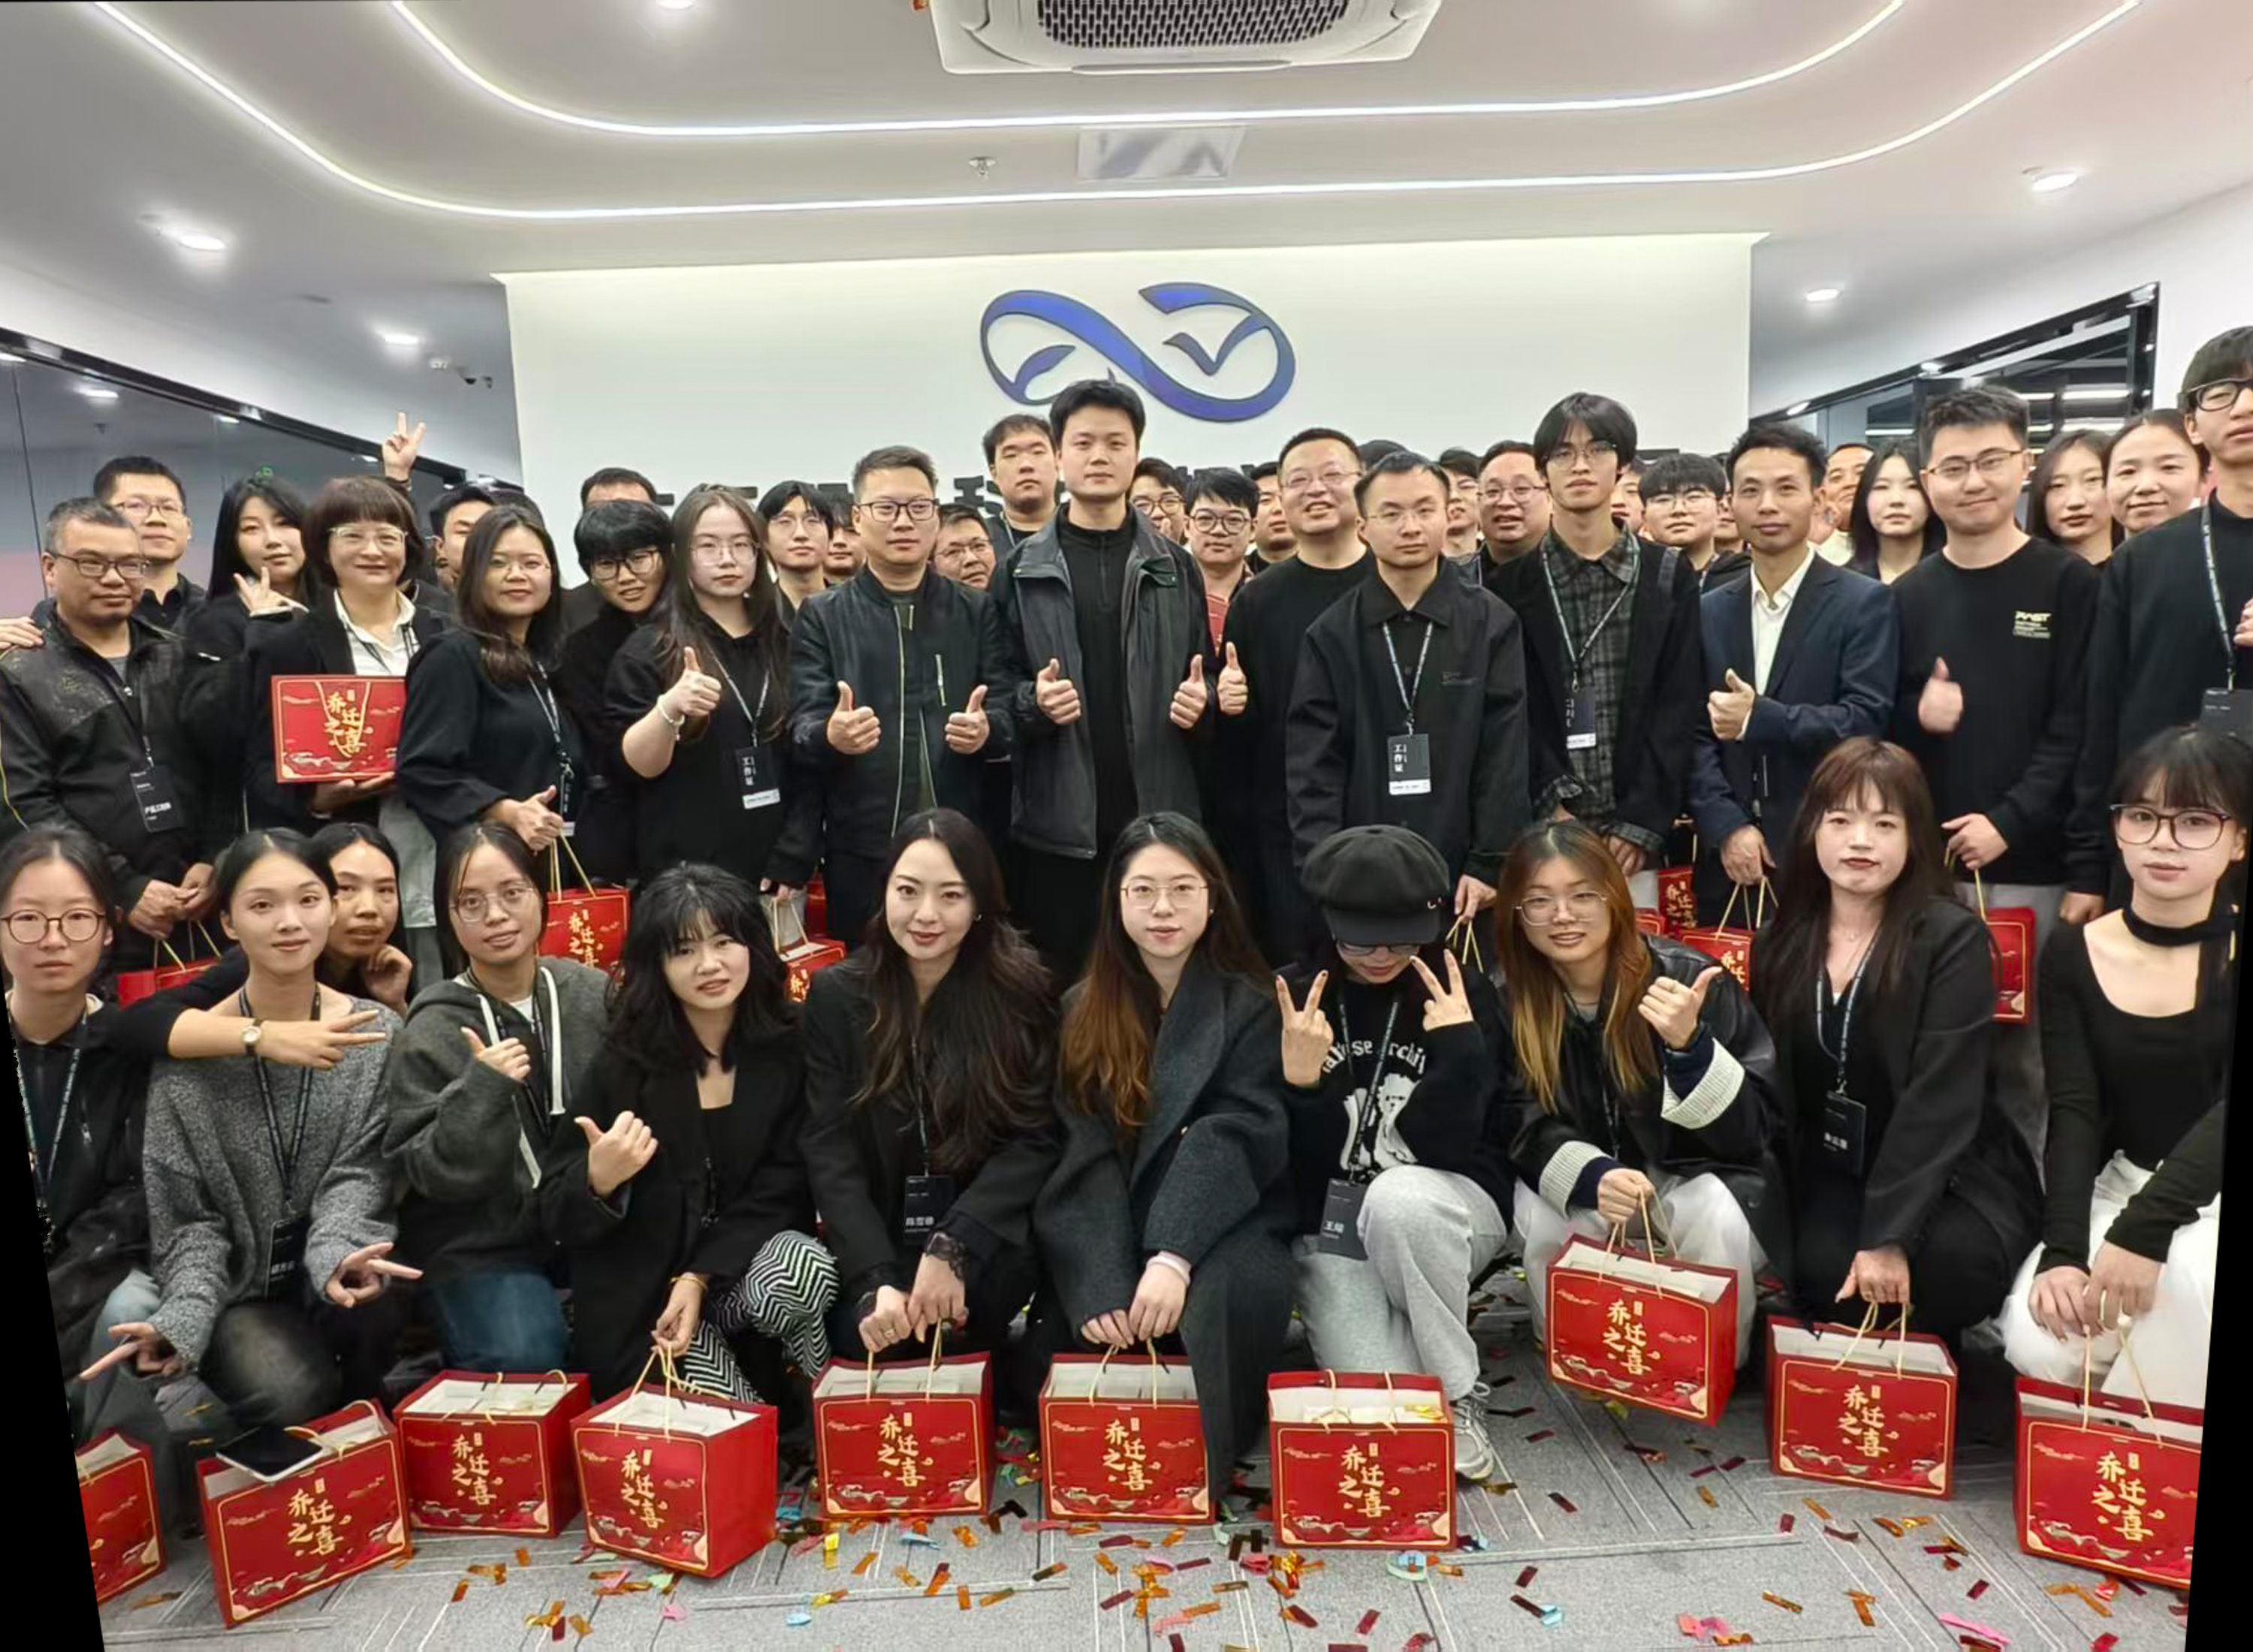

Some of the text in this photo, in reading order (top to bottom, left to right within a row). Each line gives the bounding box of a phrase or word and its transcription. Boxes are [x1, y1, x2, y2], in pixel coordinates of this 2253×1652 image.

[324, 691, 367, 753] 乔迁之喜
[569, 911, 599, 970] 乔迁之喜
[1720, 950, 1745, 984] 乔迁
[1602, 1298, 1652, 1376] 乔迁之喜
[877, 1412, 926, 1488] 乔迁之喜
[1102, 1418, 1154, 1491] 乔迁之喜
[1838, 1384, 1889, 1458] 乔迁之喜
[452, 1433, 497, 1506] 乔迁之喜
[620, 1449, 665, 1529] 乔迁之喜
[1338, 1443, 1392, 1518] 乔迁之喜
[2091, 1450, 2154, 1542] 乔迁之喜
[288, 1488, 345, 1556] 乔迁之喜
